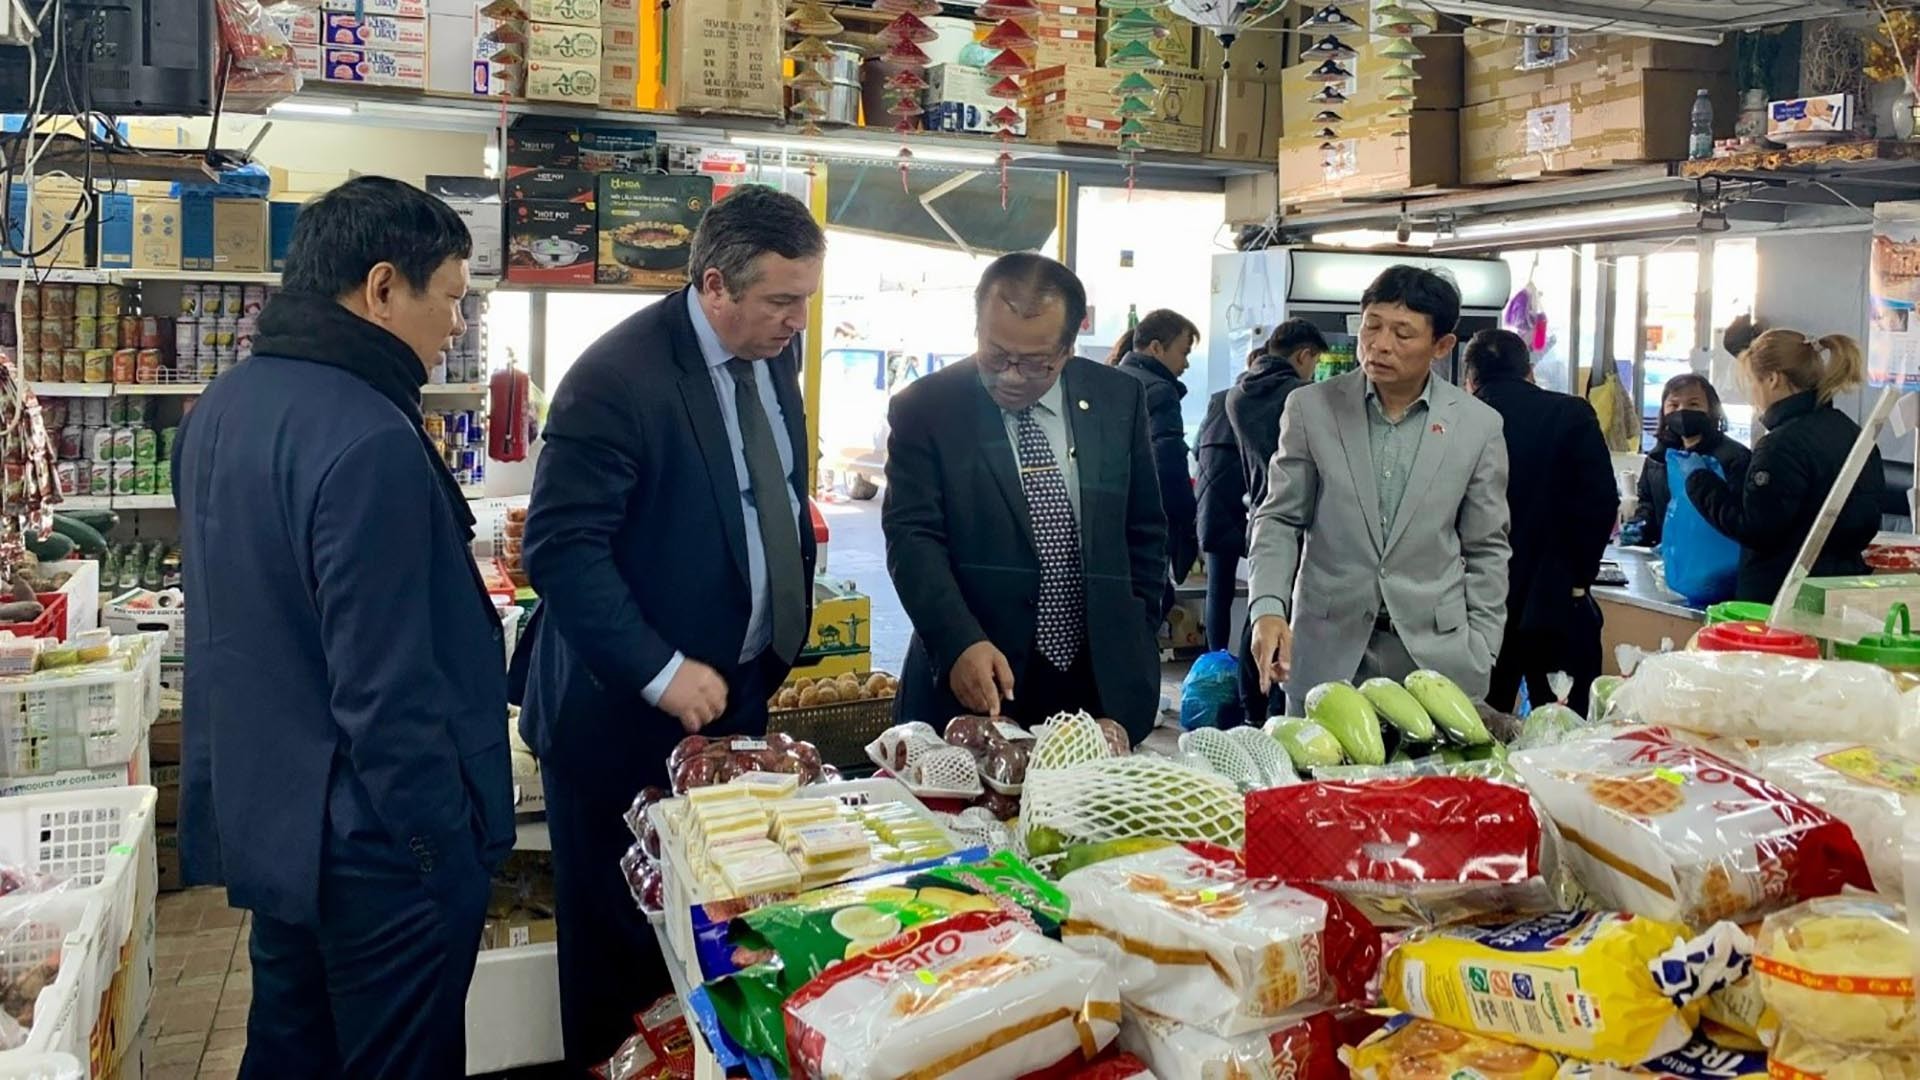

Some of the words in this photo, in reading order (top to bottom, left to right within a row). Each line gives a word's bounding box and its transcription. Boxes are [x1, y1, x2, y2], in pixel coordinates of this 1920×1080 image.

[553, 35, 574, 58] 순
[552, 73, 573, 96] 순
[537, 210, 554, 218] HOT
[555, 211, 570, 219] POT
[55, 778, 68, 787] OF
[69, 775, 97, 785] COSTA
[97, 771, 117, 781] RICA
[864, 930, 963, 986] Karo
[1300, 930, 1321, 998] Kar
